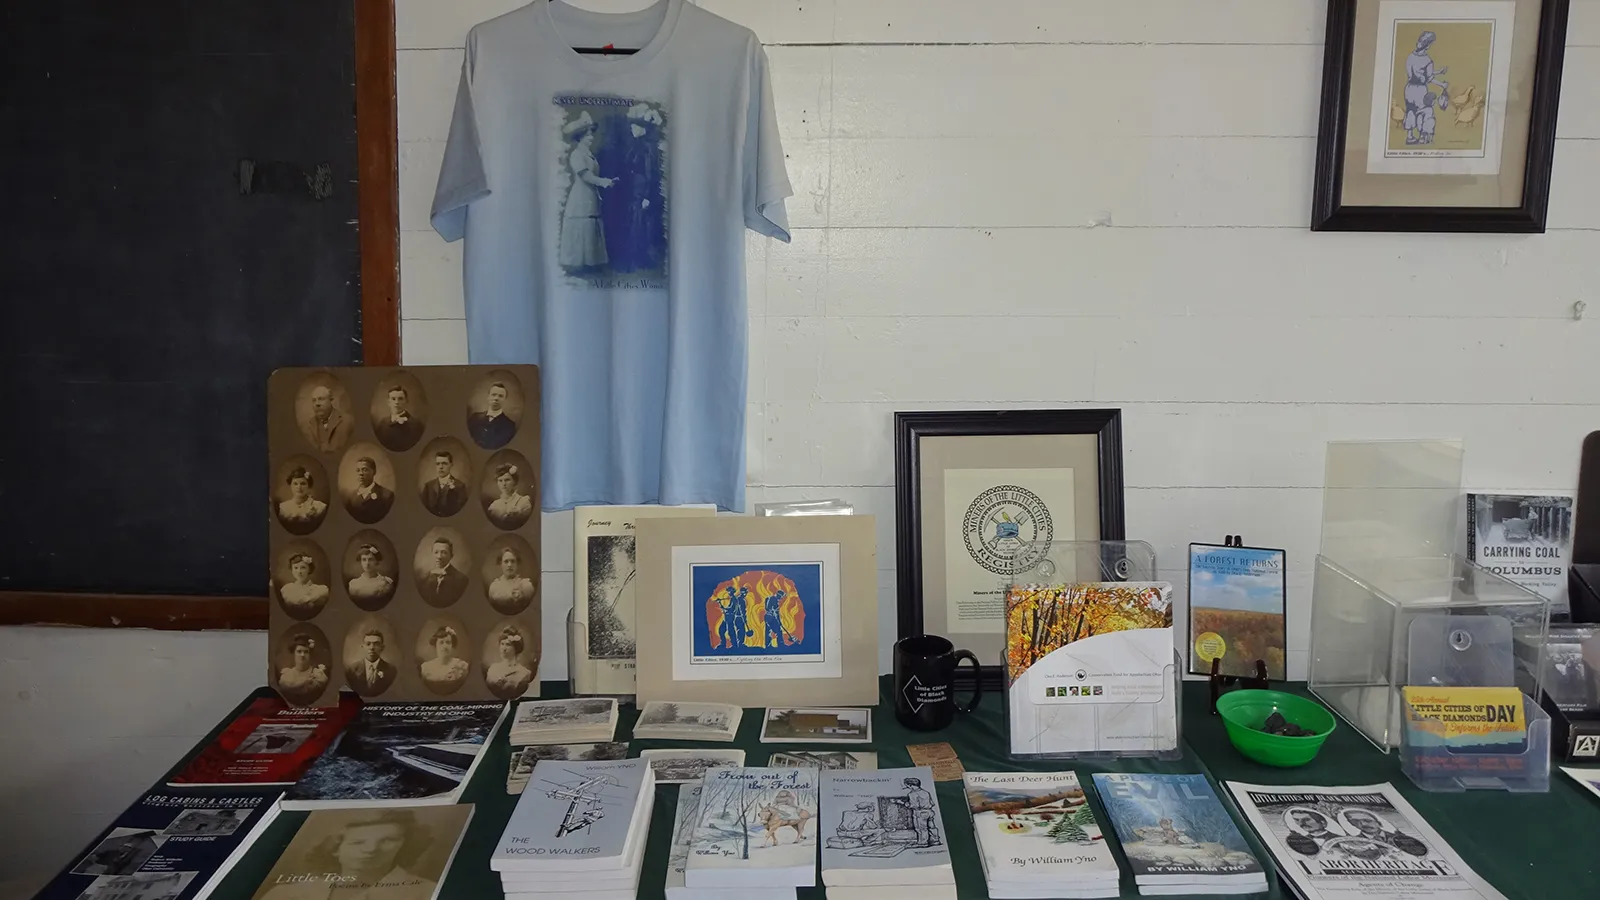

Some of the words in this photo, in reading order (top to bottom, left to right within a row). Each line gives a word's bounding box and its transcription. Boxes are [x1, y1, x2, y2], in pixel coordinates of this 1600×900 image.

[969, 503, 988, 533] MINERS
[984, 496, 994, 505] OF
[994, 492, 1008, 501] THE
[1011, 492, 1035, 508] LITTLE
[1031, 505, 1047, 532] CITIES
[587, 518, 612, 528] Journey
[1483, 546, 1531, 558] CARRYING
[1535, 546, 1560, 558] COAL
[1204, 556, 1236, 565] FOREST
[1240, 558, 1279, 569] RETURNS
[1411, 704, 1442, 712] LITTLE
[1444, 704, 1472, 712] CITIES
[1486, 704, 1516, 722] DAY
[718, 770, 756, 780] From
[761, 772, 782, 780] out
[786, 771, 799, 784] of
[970, 775, 989, 783] The
[748, 780, 765, 790] the
[770, 780, 812, 790] Forest
[1106, 782, 1210, 800] EVIL
[170, 796, 206, 804] CABINS
[1250, 793, 1278, 803] LITTLE
[549, 846, 601, 854] WALKERS
[1010, 856, 1026, 867] By
[1028, 856, 1074, 865] William
[1298, 860, 1362, 876] LABOR
[1365, 860, 1460, 876] HERITAGE
[274, 873, 318, 884] Little
[323, 872, 358, 882] Toes
